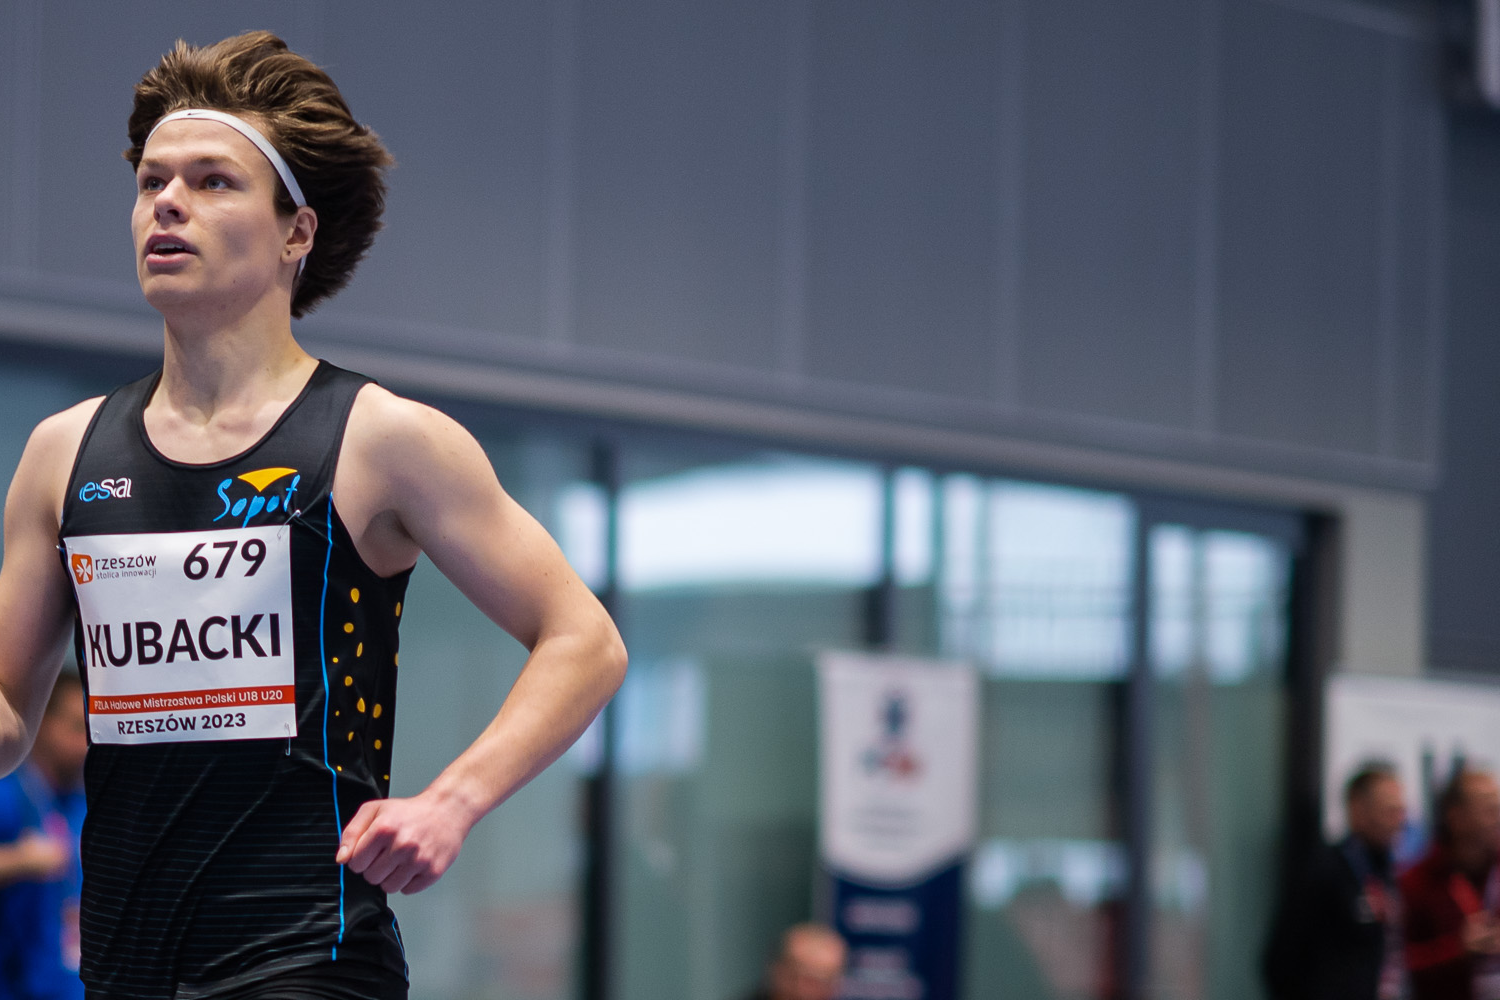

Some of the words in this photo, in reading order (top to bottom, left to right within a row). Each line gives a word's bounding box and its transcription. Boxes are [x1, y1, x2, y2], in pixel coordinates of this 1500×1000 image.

[212, 474, 301, 528] Sopot
[95, 554, 157, 571] rzeszów
[183, 538, 267, 580] 679
[96, 571, 119, 580] stolica
[121, 568, 157, 578] innowacji
[87, 612, 282, 668] KUBACKI
[94, 700, 110, 711] PZLA
[111, 699, 141, 710] Halowe
[143, 695, 203, 709] Mistrzostwa
[205, 692, 236, 704] Polski
[238, 690, 259, 702] U18
[261, 689, 283, 701] U20
[117, 713, 197, 735] RZESZÓW
[201, 712, 247, 730] 2023
